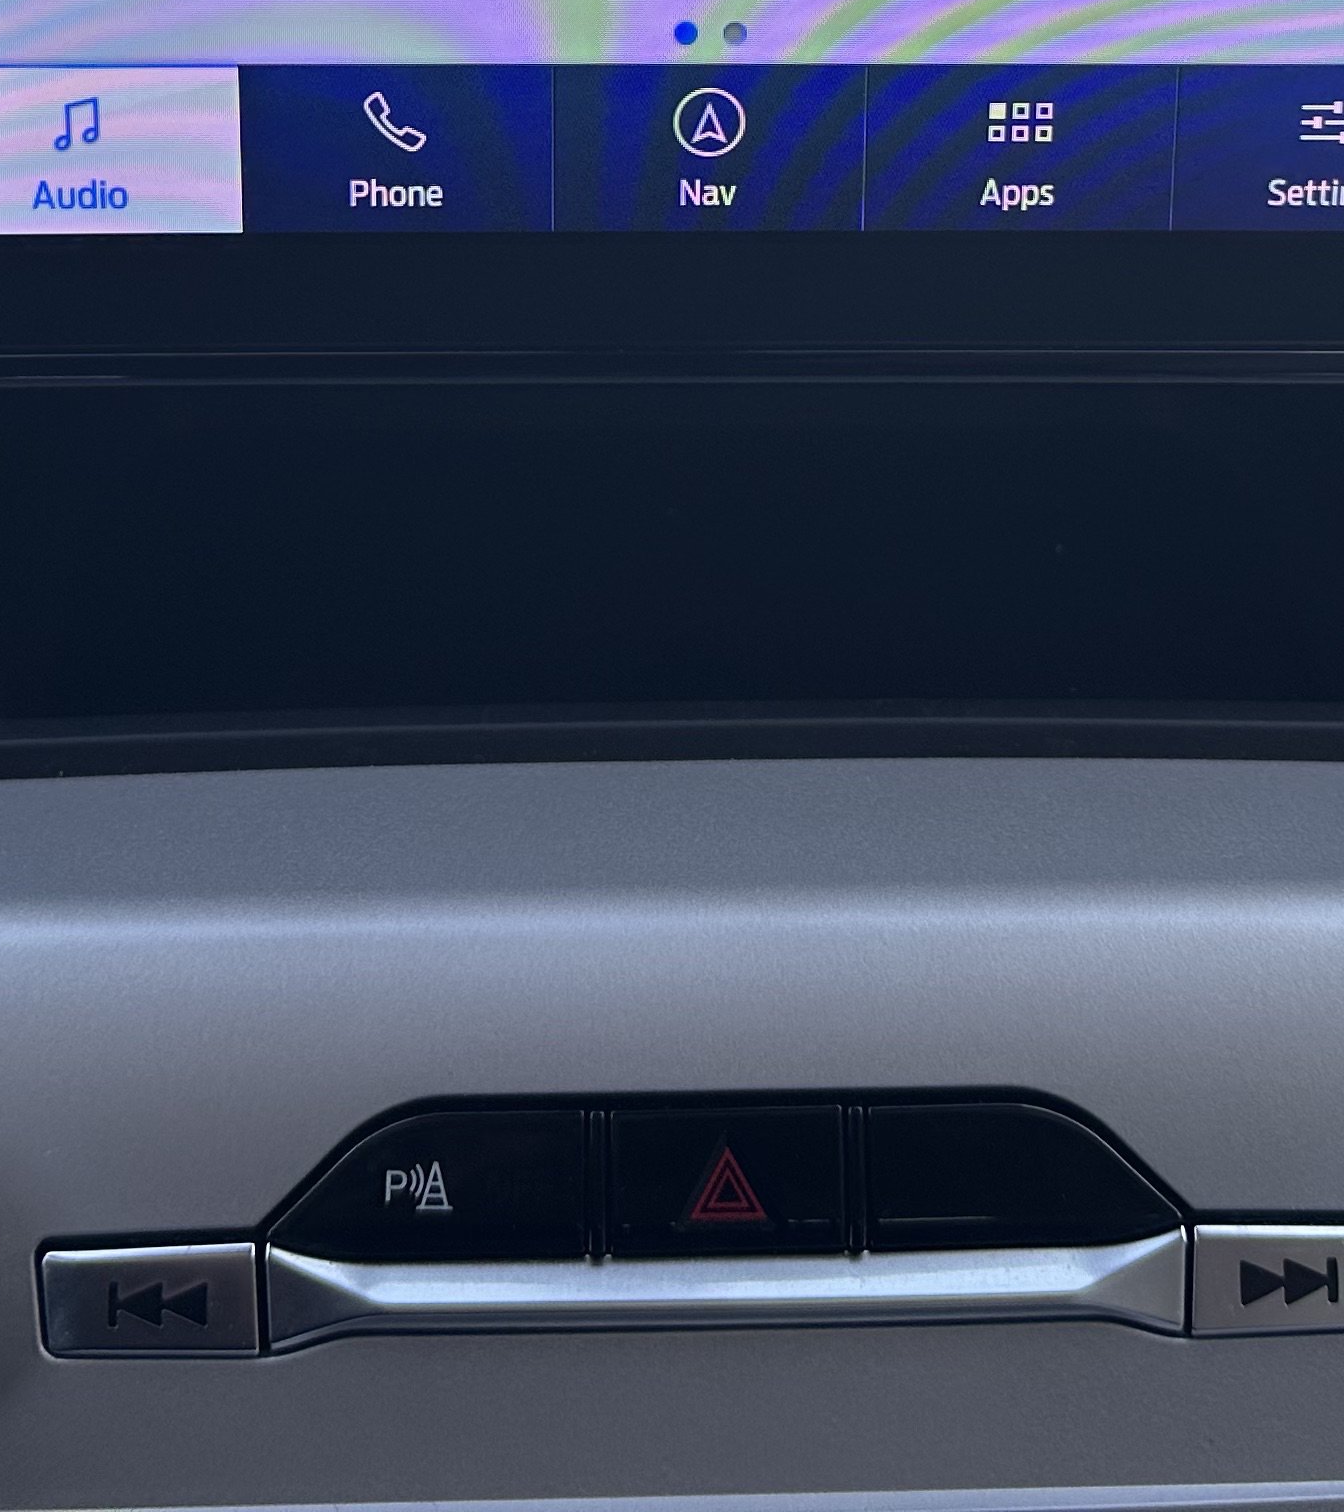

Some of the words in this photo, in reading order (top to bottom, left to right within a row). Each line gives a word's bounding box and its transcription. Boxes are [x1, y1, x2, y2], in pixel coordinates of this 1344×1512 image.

[32, 180, 129, 211] Audio
[349, 179, 444, 208] Phone
[678, 180, 737, 207] Nav
[980, 178, 1056, 214] Apps
